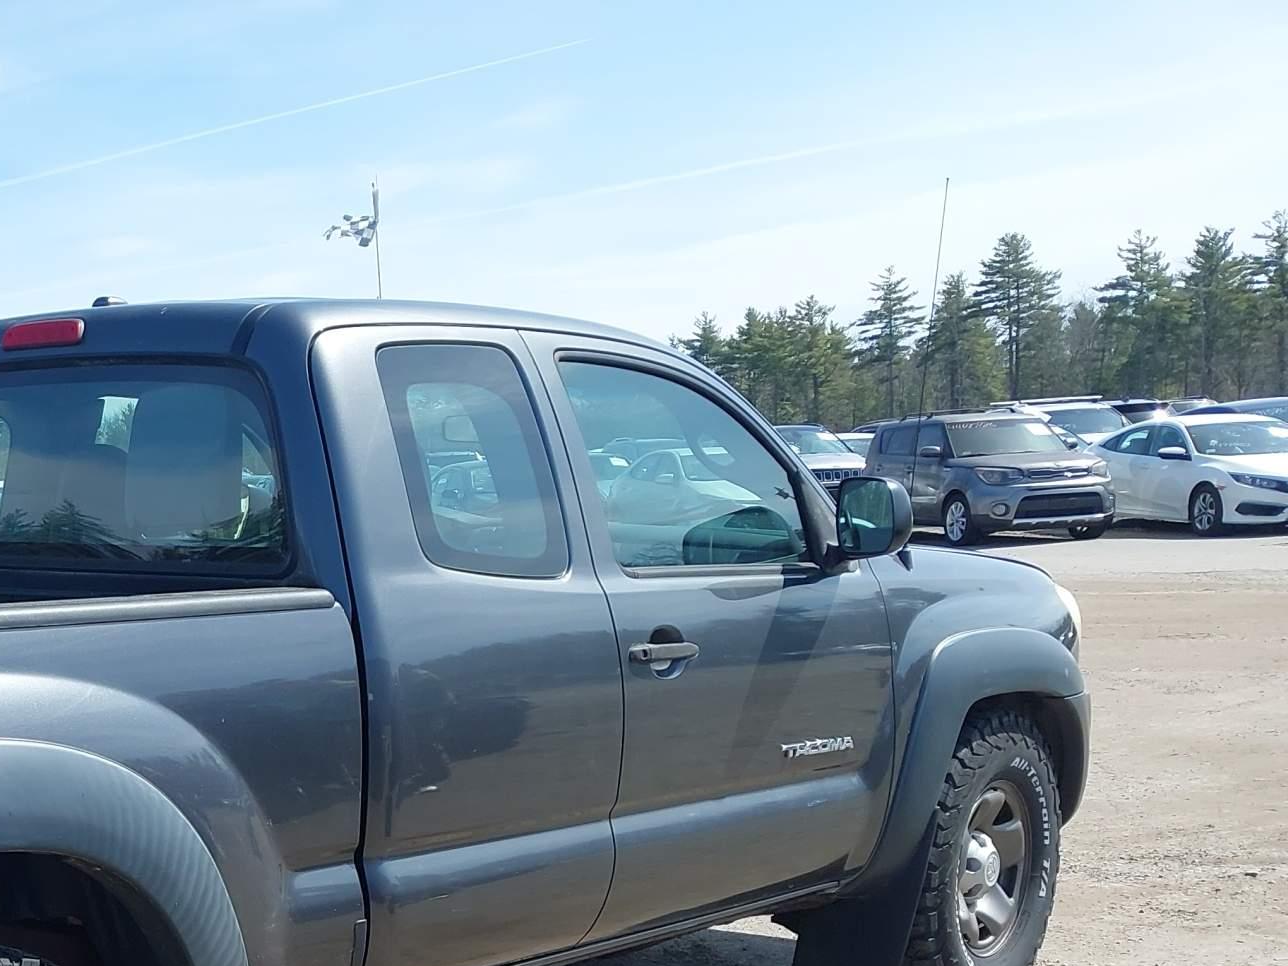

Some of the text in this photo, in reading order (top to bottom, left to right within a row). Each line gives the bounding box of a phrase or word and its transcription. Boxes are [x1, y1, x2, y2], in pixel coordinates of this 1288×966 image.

[780, 736, 855, 758] TACOMA
[1010, 757, 1051, 897] All-Terrain T/A
